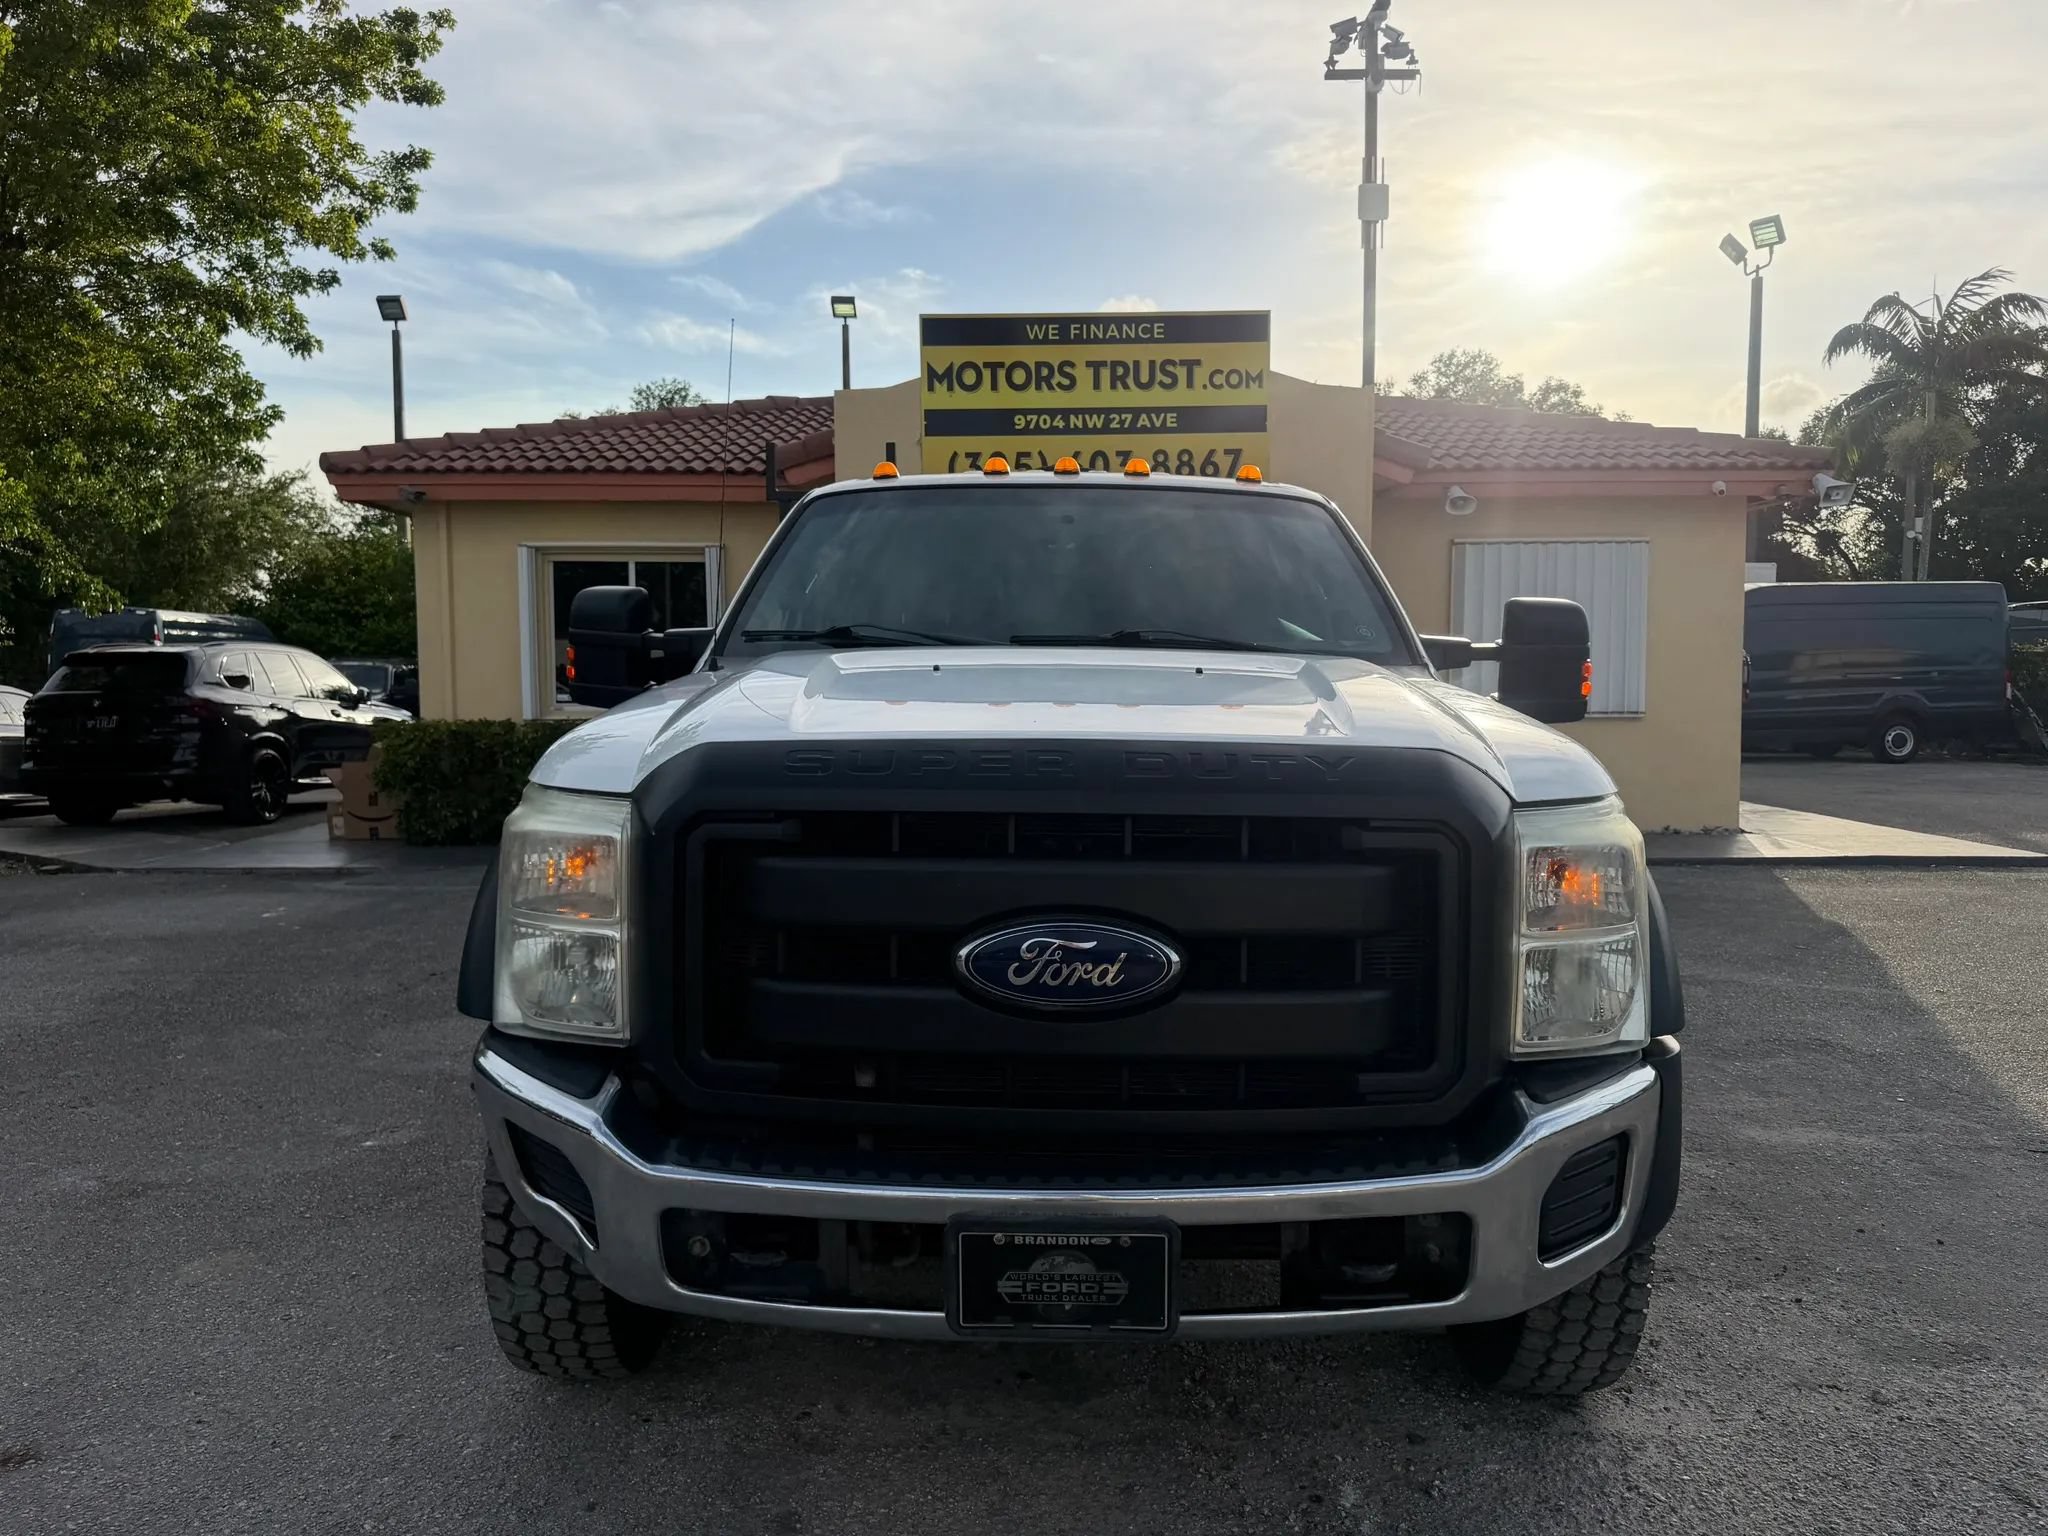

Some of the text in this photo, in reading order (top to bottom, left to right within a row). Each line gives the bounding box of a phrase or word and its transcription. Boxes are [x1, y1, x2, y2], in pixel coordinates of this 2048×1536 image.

[1026, 323, 1165, 340] WE FINANCE
[926, 358, 1264, 394] MOTORS TRUST.COM
[1013, 412, 1178, 430] 9704 NW 27 AVE
[948, 449, 1049, 474] (35)
[1150, 448, 1243, 479] 8867
[783, 748, 1358, 783] SUPER DUTY
[1007, 937, 1127, 987] Ford
[1013, 1235, 1090, 1246] BRANDON
[1010, 1273, 1117, 1282] WORLD'S LARGEST
[1025, 1282, 1100, 1293] FORD
[1020, 1293, 1107, 1302] TRUCK DEALER
